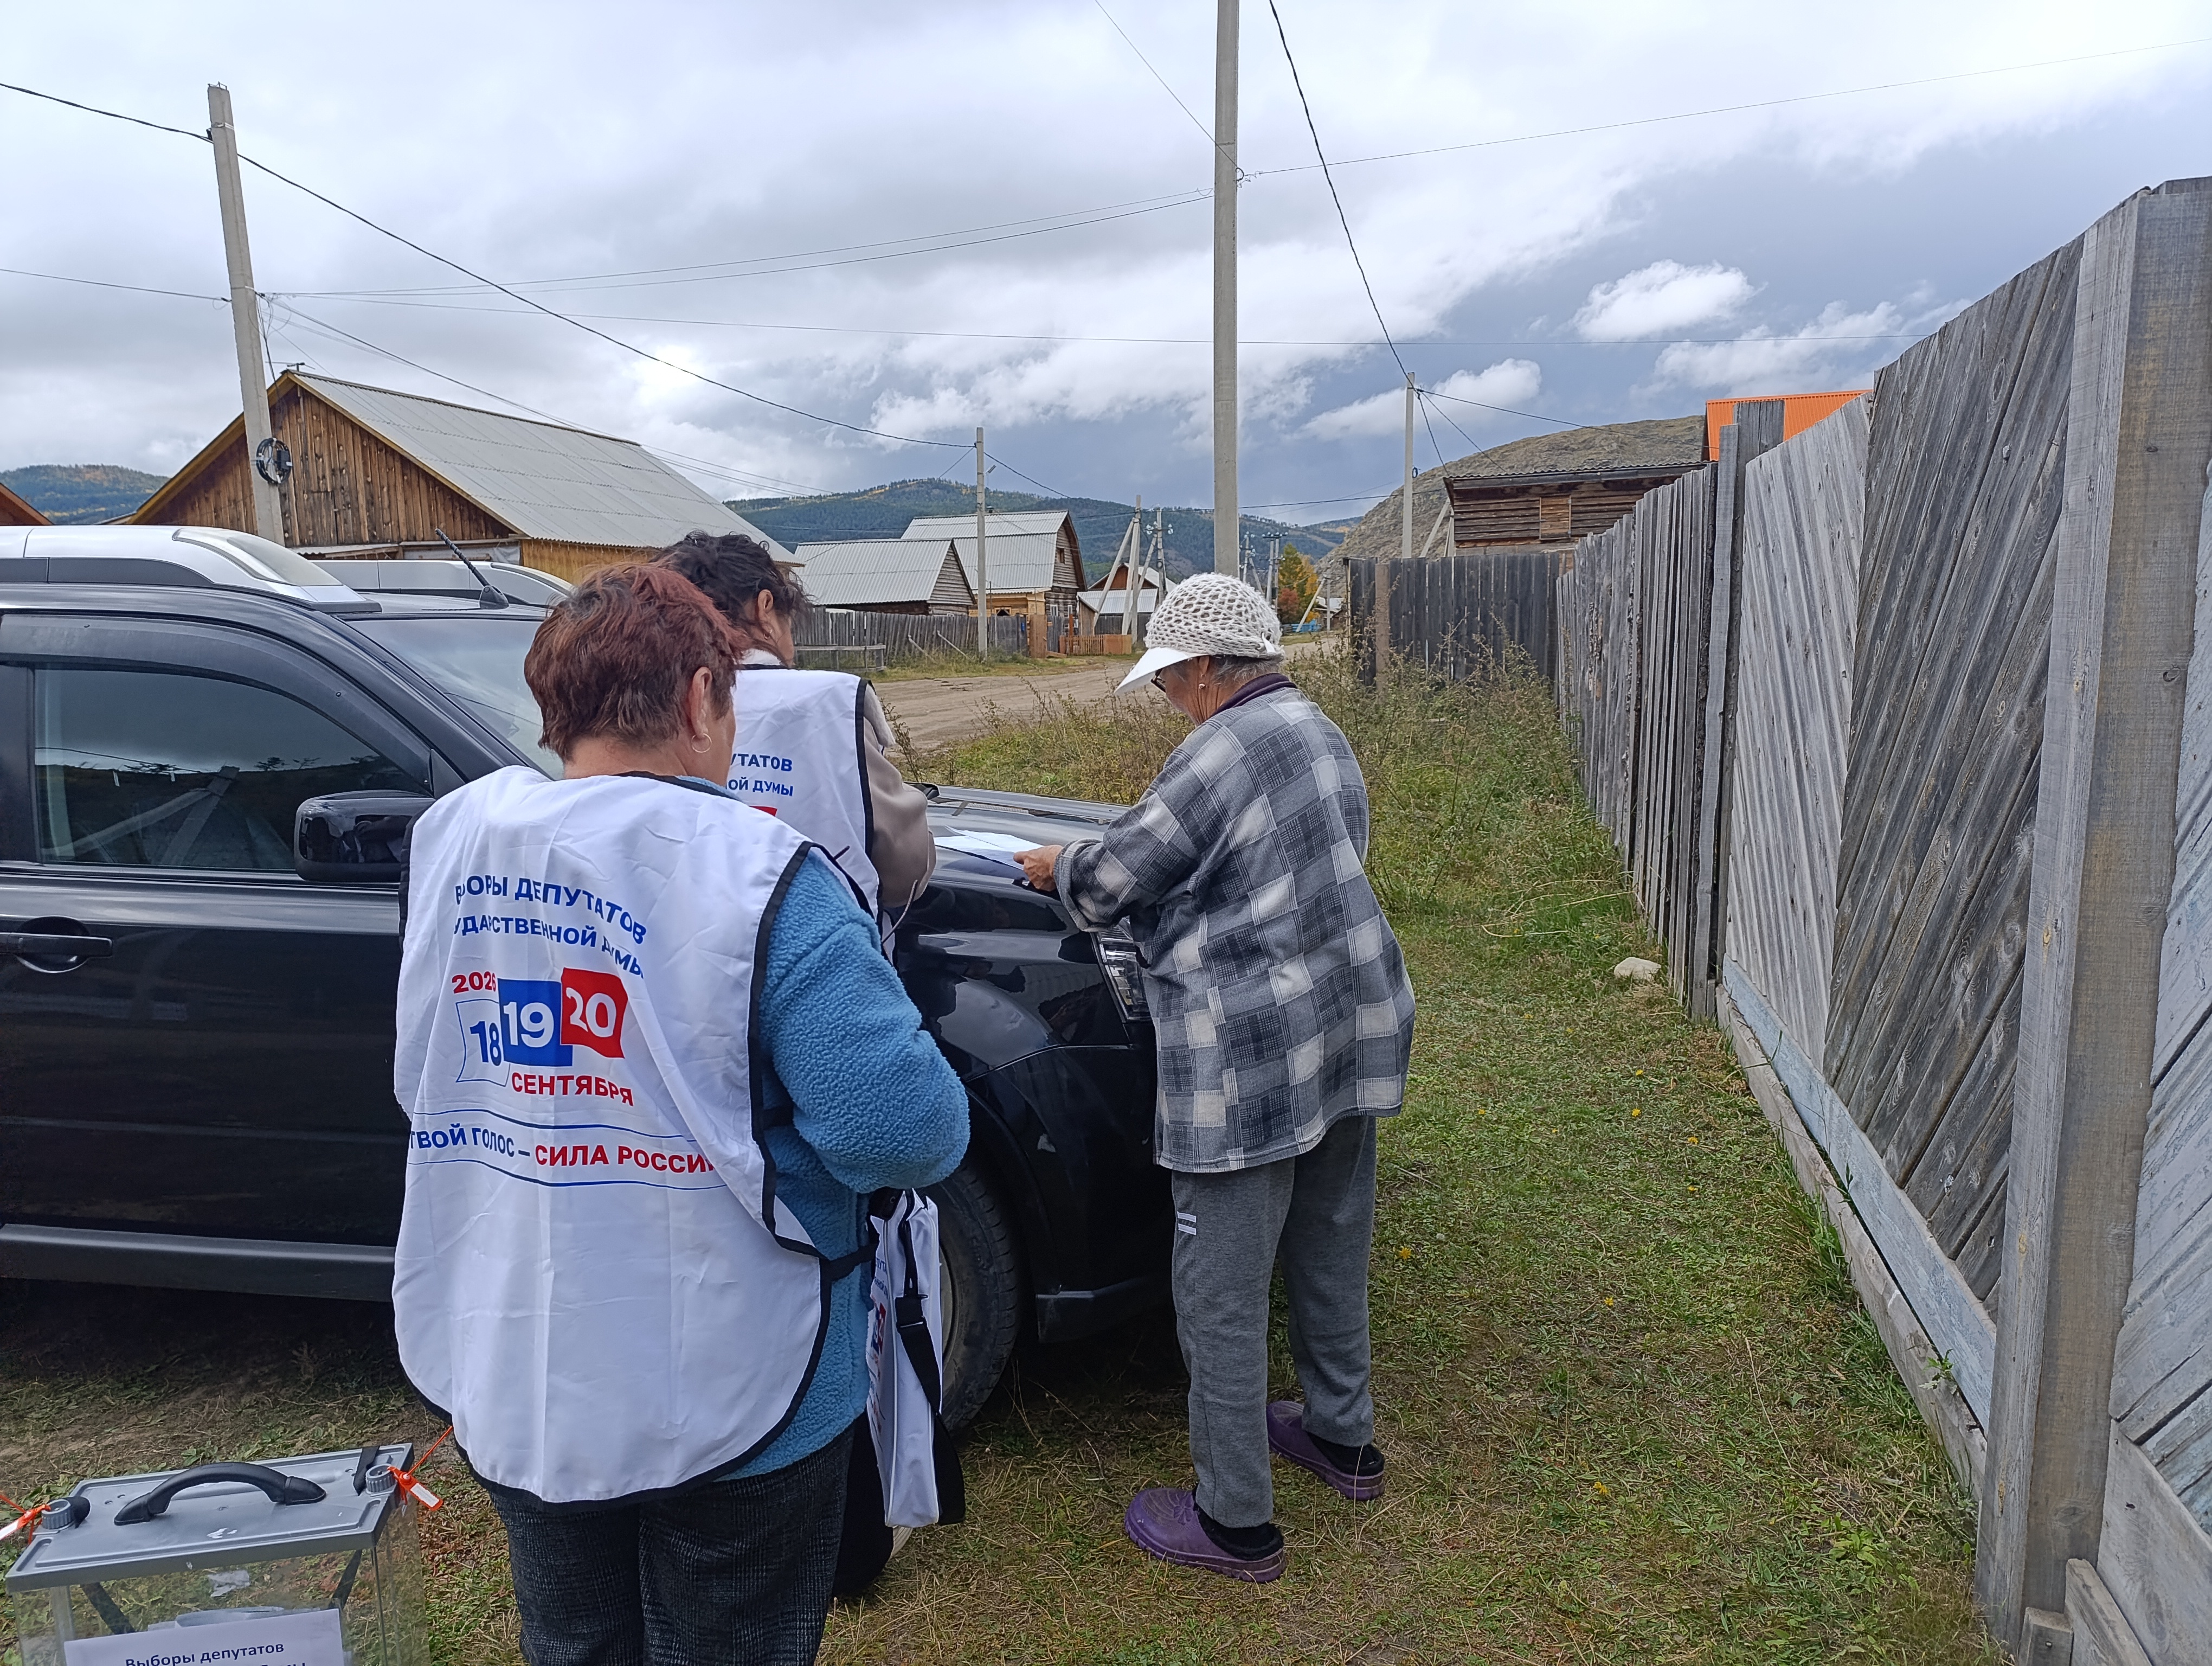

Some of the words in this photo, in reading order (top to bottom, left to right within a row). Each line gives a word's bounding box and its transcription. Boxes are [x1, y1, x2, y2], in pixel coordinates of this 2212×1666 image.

[726, 777, 748, 791] ОЙ
[753, 780, 793, 797] ДУМЫ
[455, 875, 508, 905] ВОРЫ
[515, 877, 647, 944] ДЕПУТАТОВ
[452, 971, 496, 994] 2026
[470, 1021, 502, 1066] 18
[503, 1002, 554, 1048] 19
[565, 987, 616, 1038] 20
[512, 1072, 634, 1107] СЕНТЯБРЯ
[472, 1127, 515, 1157] ГОЛОС
[535, 1145, 609, 1167] СИЛА
[125, 1653, 195, 1666] Выборы
[200, 1643, 284, 1664] депутатов
